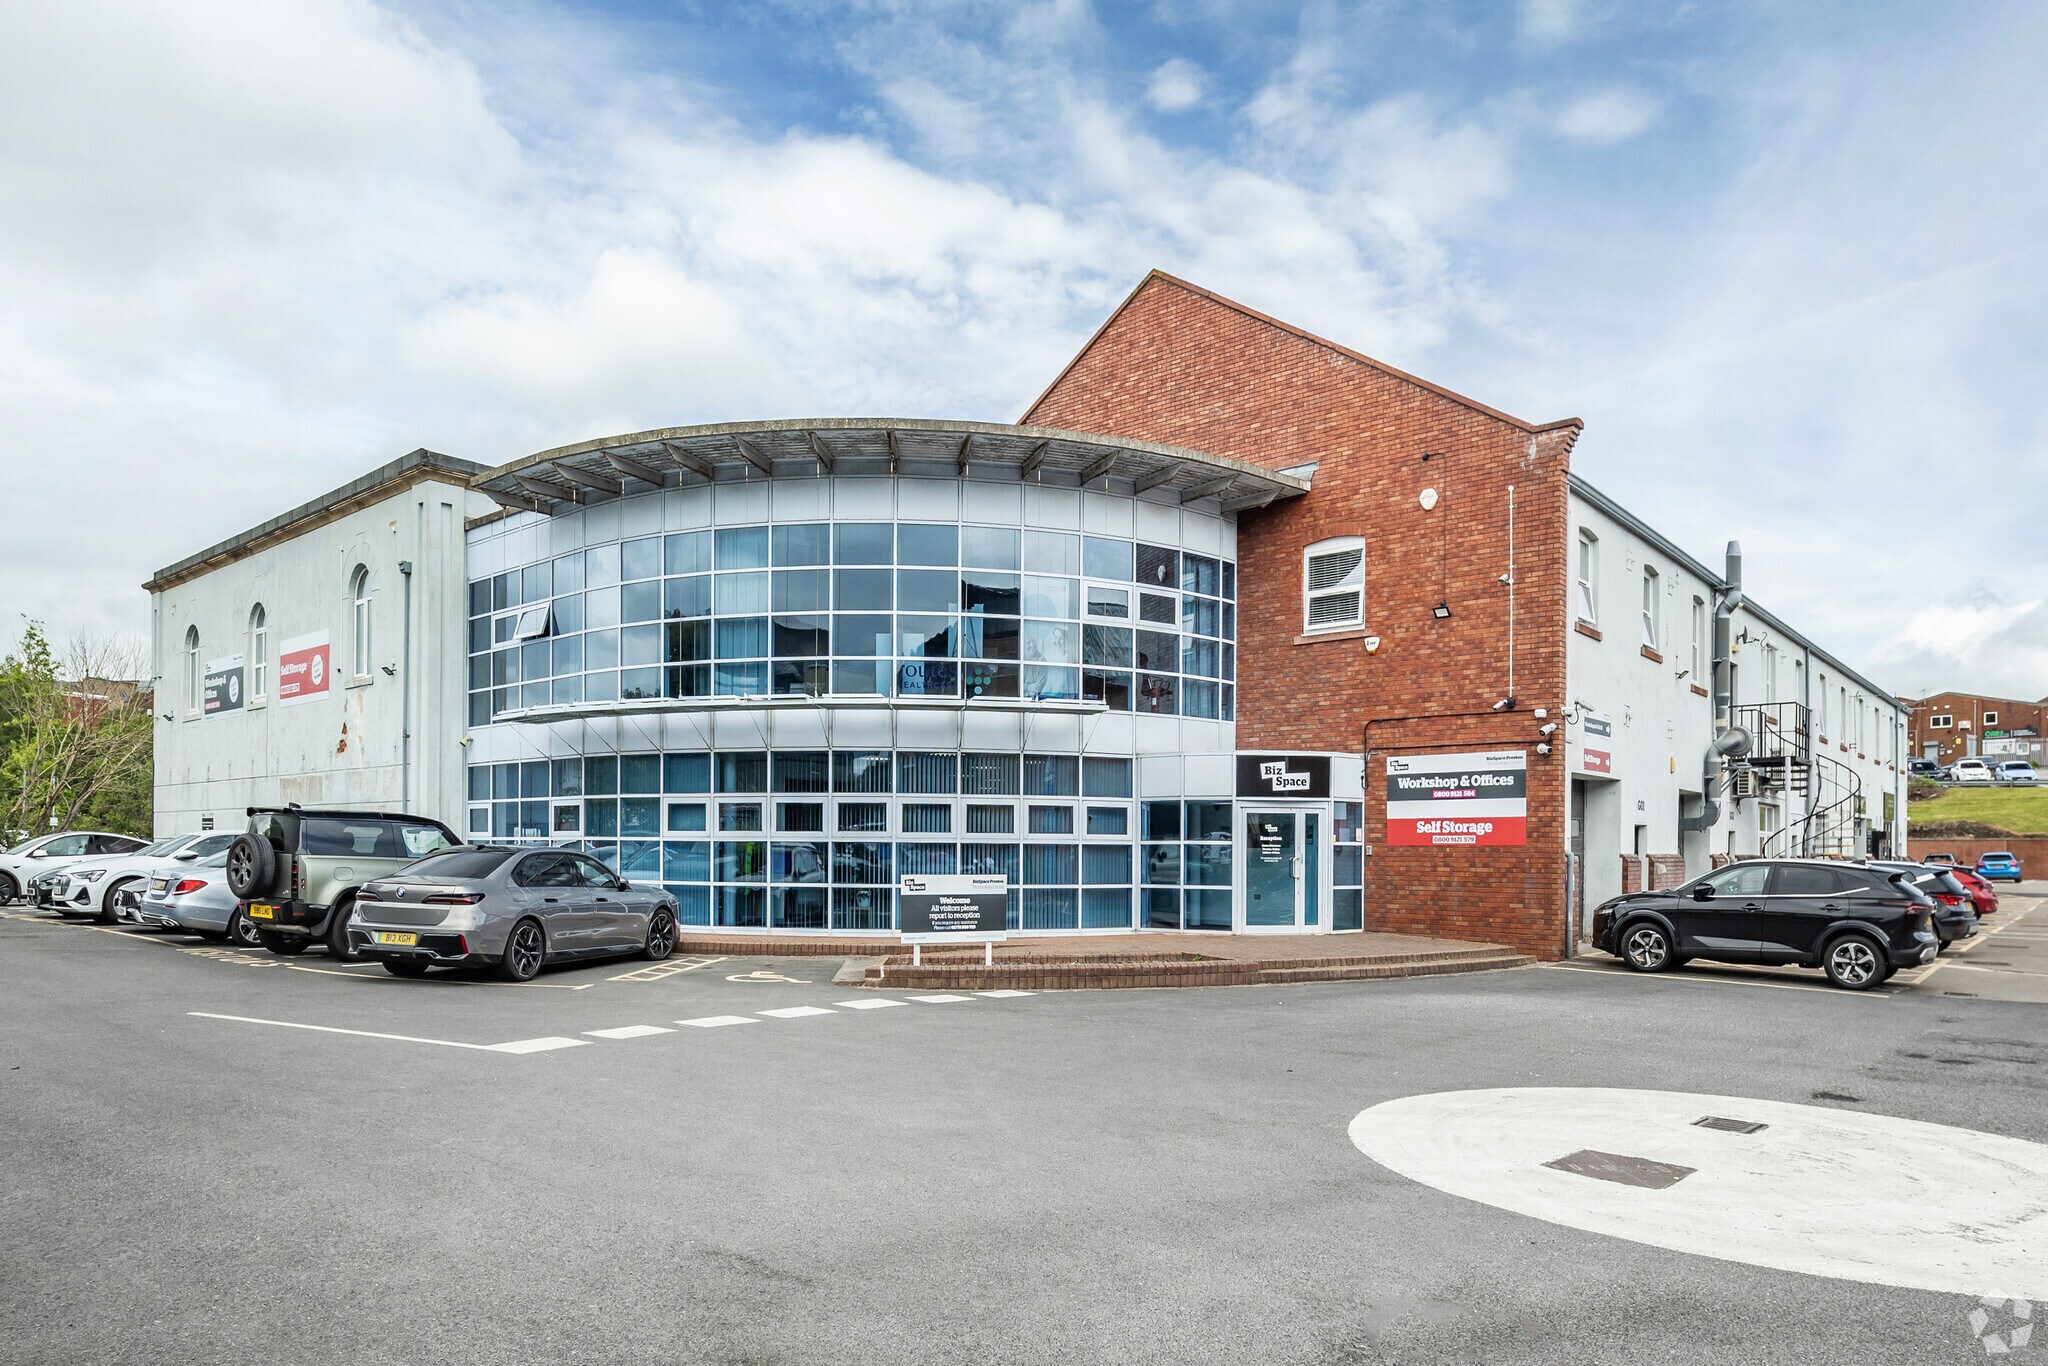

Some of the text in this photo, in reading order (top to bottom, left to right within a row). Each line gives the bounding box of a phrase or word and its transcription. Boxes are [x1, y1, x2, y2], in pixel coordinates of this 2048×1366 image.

[1264, 766, 1282, 775] Biz
[1276, 777, 1307, 787] Space
[1397, 774, 1514, 789] Workshop & Offices
[1416, 821, 1493, 835] Self Storage
[954, 912, 981, 920] reception
[397, 934, 411, 943] XGH
